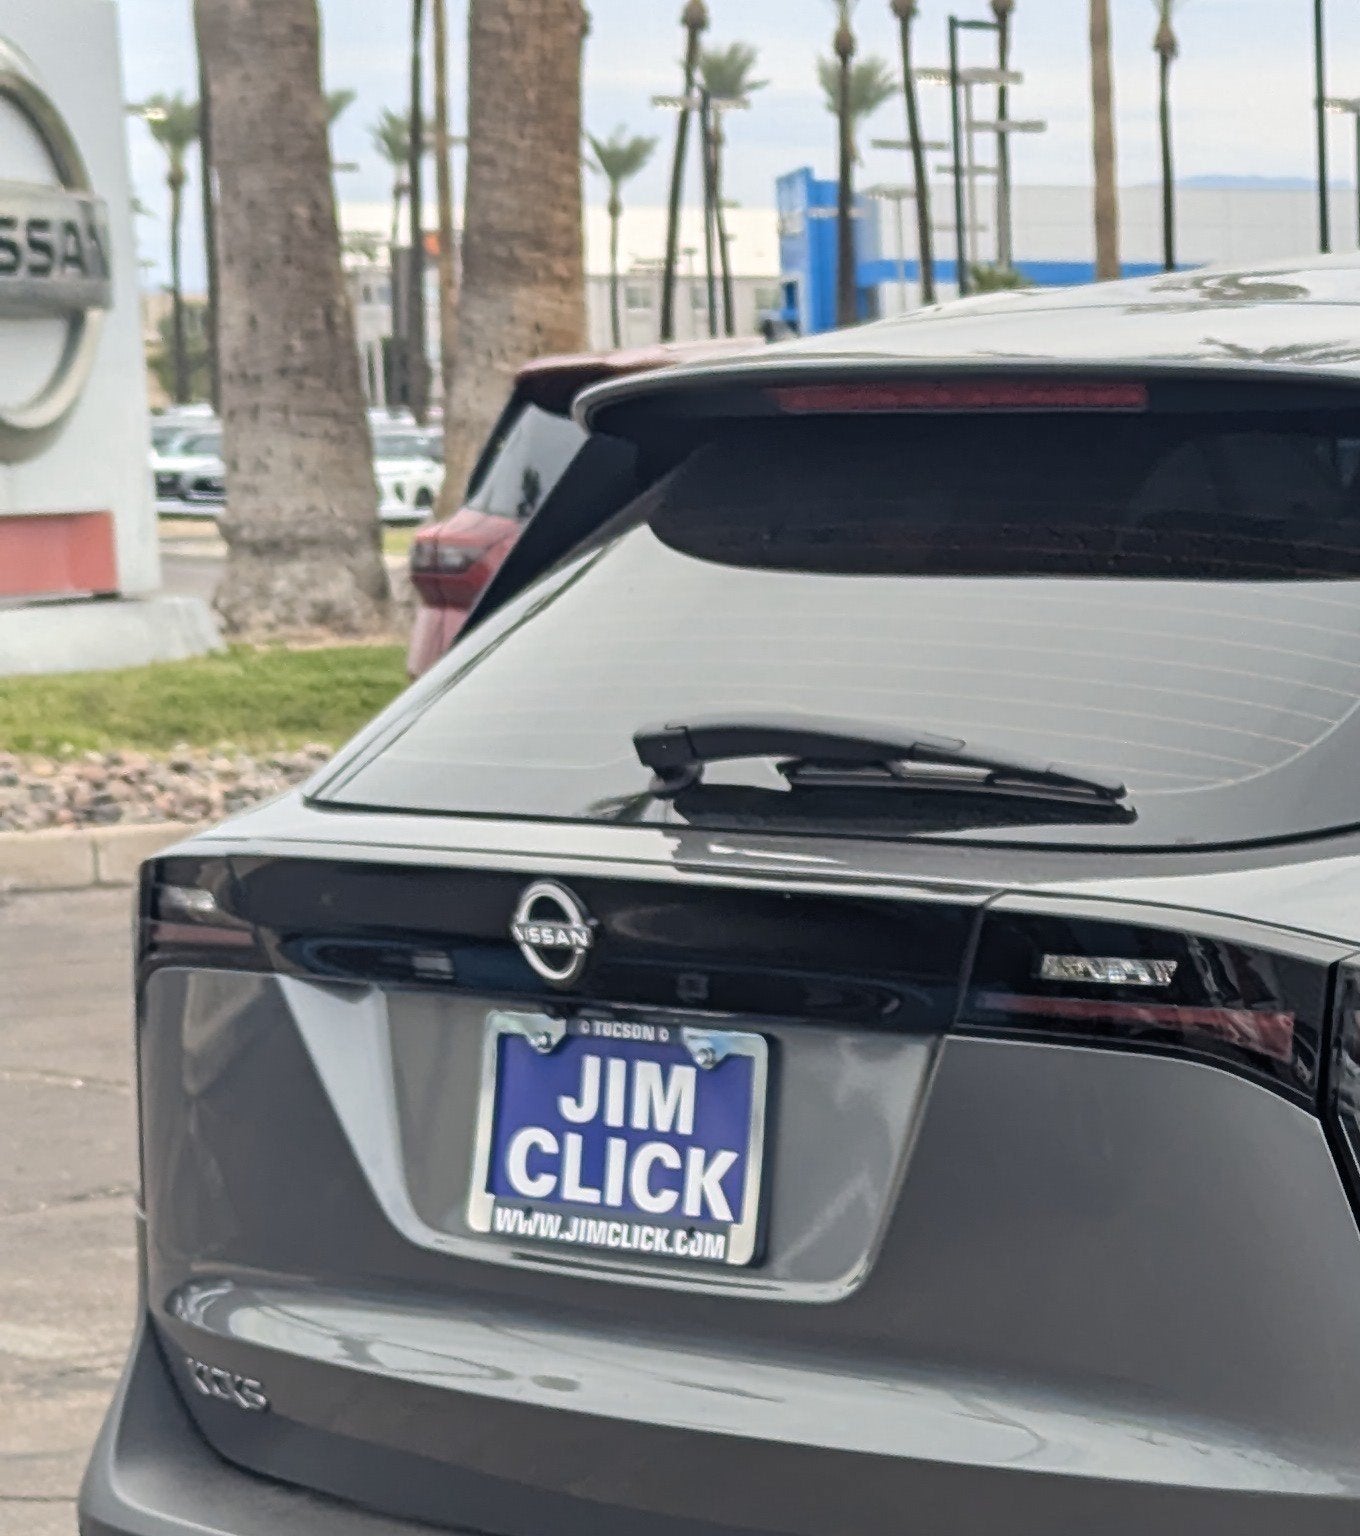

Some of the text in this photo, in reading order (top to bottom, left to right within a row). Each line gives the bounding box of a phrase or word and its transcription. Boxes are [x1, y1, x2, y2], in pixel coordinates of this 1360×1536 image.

[514, 925, 589, 947] NISSAN
[592, 1020, 656, 1041] TUCSON
[557, 1053, 697, 1135] JIM
[505, 1126, 739, 1222] CLICK
[495, 1206, 726, 1260] WWW.JIMCLICK.COM
